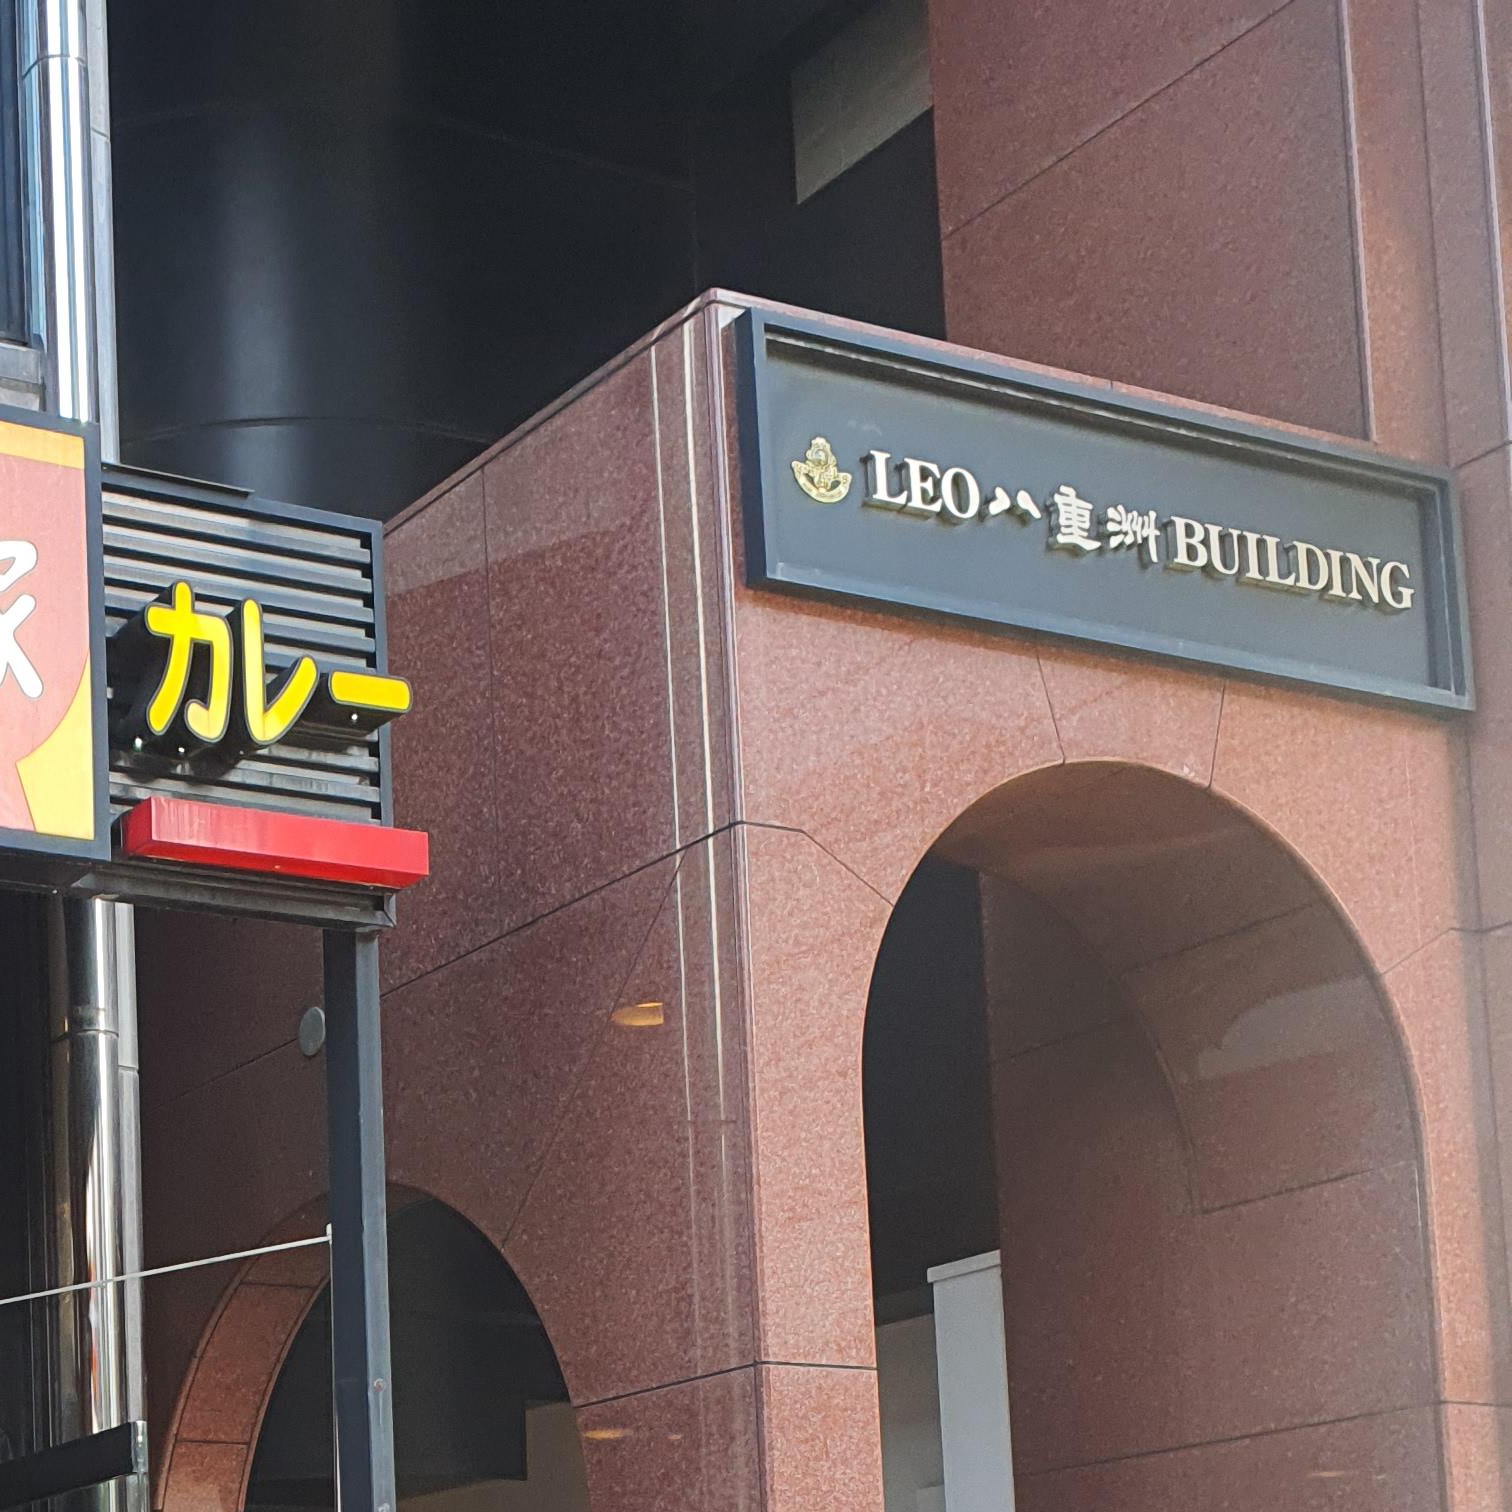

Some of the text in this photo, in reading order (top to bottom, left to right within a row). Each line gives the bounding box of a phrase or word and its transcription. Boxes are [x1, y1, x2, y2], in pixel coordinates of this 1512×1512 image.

[869, 449, 981, 519] LEO
[1172, 515, 1416, 610] BUILDING
[145, 580, 413, 745] カレー
